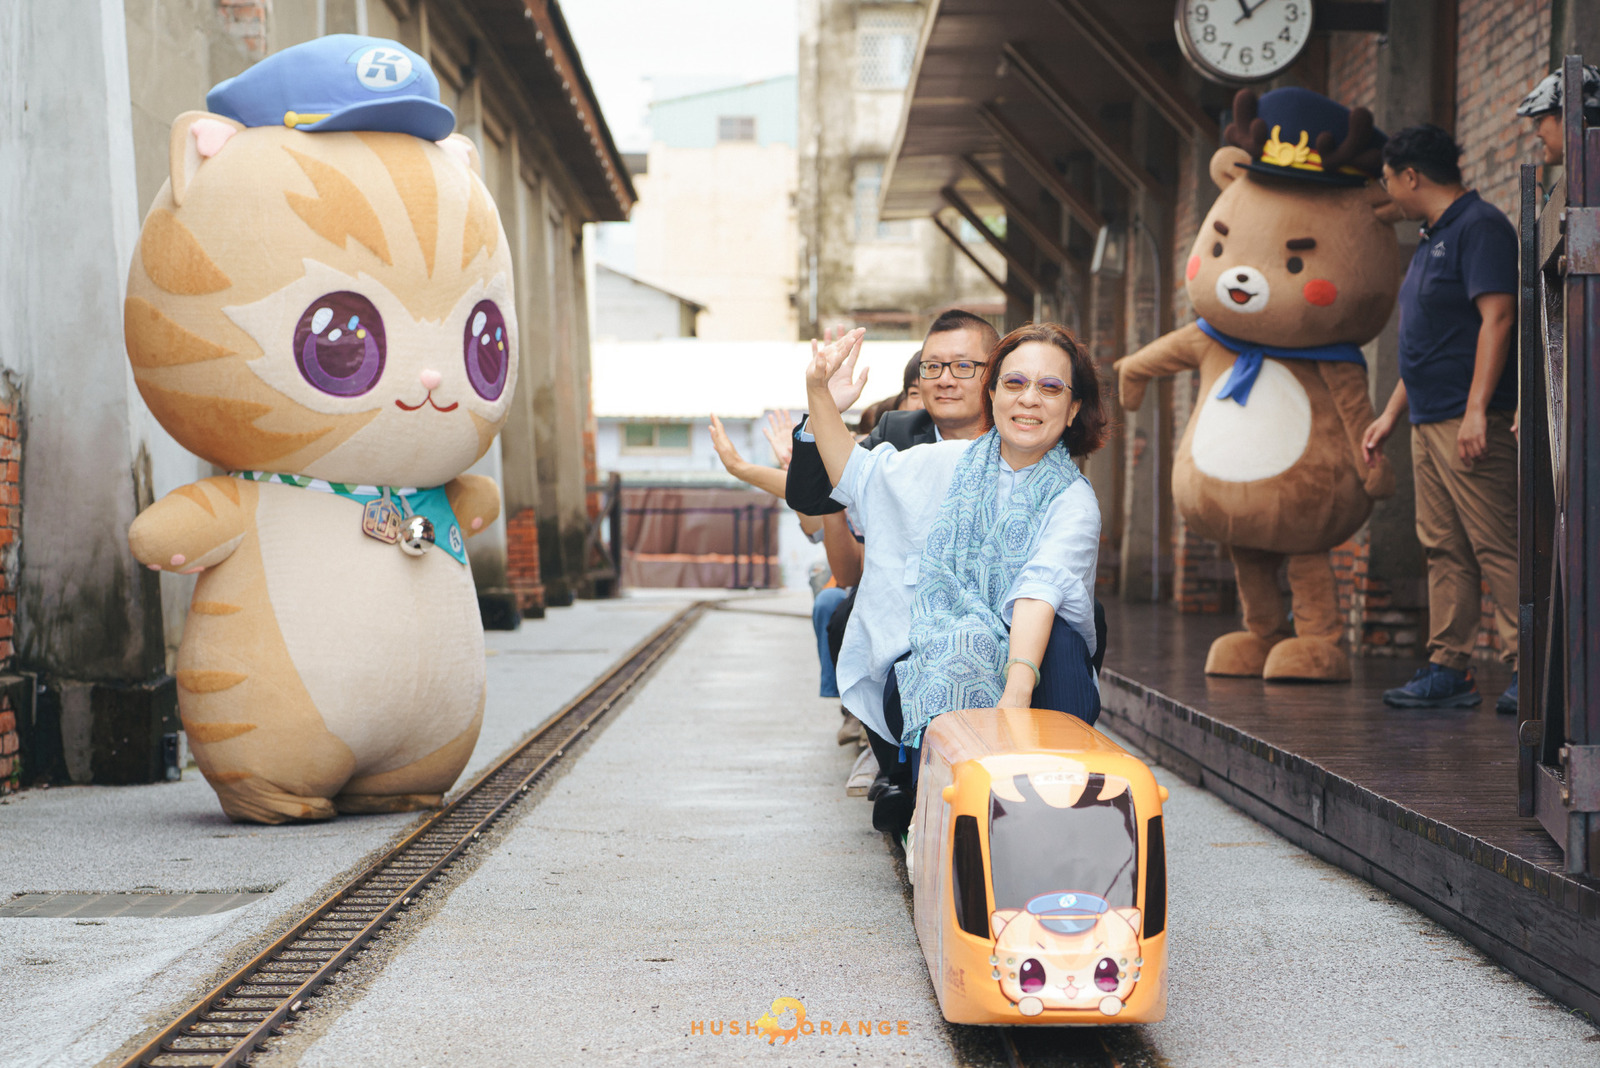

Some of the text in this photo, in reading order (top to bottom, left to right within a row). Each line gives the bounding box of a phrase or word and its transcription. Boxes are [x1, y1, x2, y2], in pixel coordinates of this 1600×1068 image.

[1195, 4, 1208, 22] 9
[1285, 3, 1298, 22] 3
[1203, 24, 1216, 43] 8
[1278, 26, 1291, 42] 4
[1221, 42, 1233, 60] 7
[1240, 46, 1253, 65] 6
[1262, 42, 1275, 60] 5
